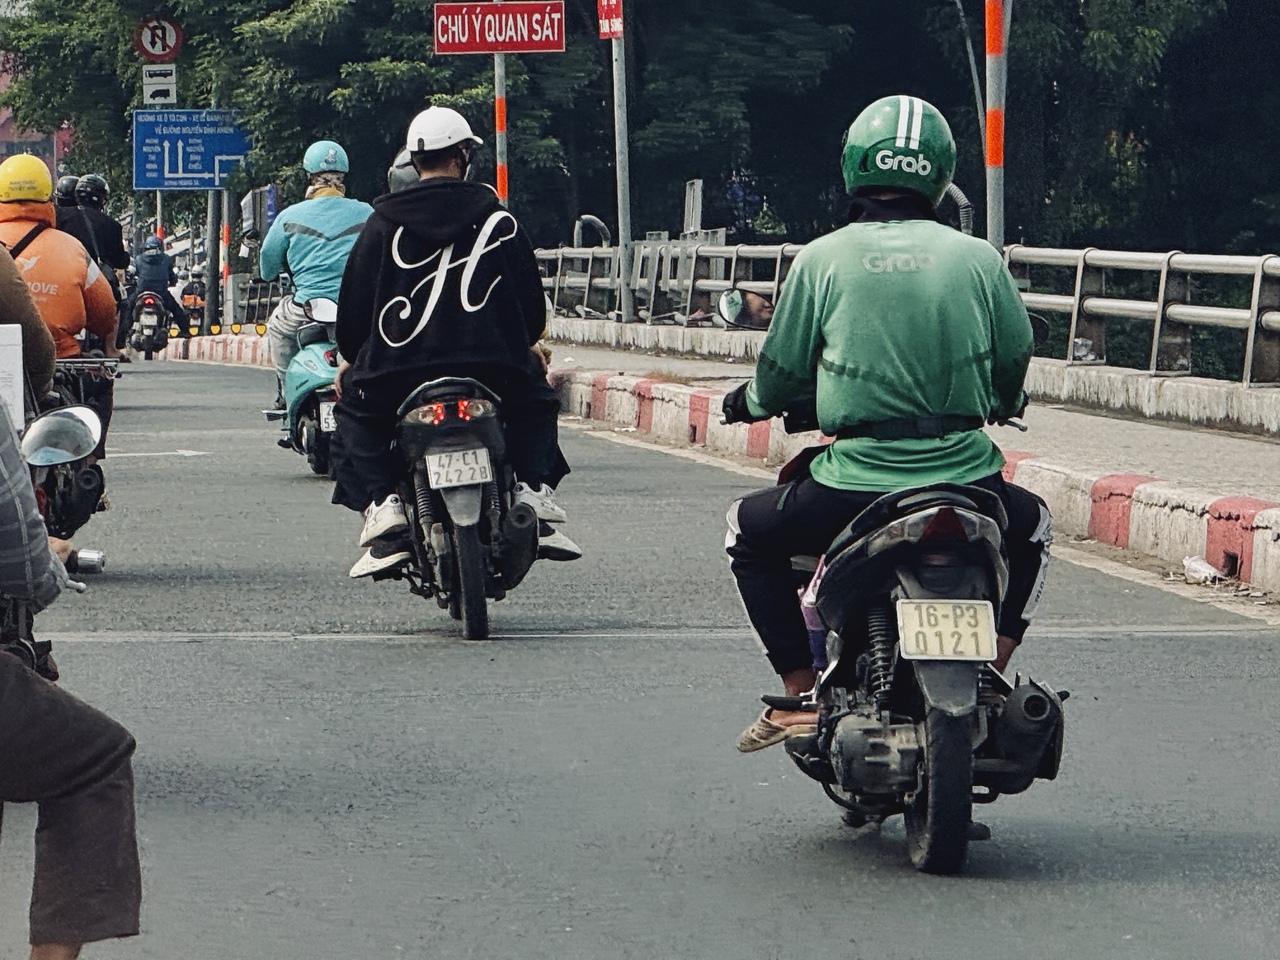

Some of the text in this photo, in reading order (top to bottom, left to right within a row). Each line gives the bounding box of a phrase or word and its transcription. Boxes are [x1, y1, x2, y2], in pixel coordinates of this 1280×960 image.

[437, 6, 561, 44] CHÚ Ý QUAN SÁT
[875, 149, 932, 176] Grab
[863, 252, 933, 274] Grab
[438, 450, 479, 469] 47-C1
[914, 604, 979, 629] 16-P3
[914, 630, 980, 656] 0121
